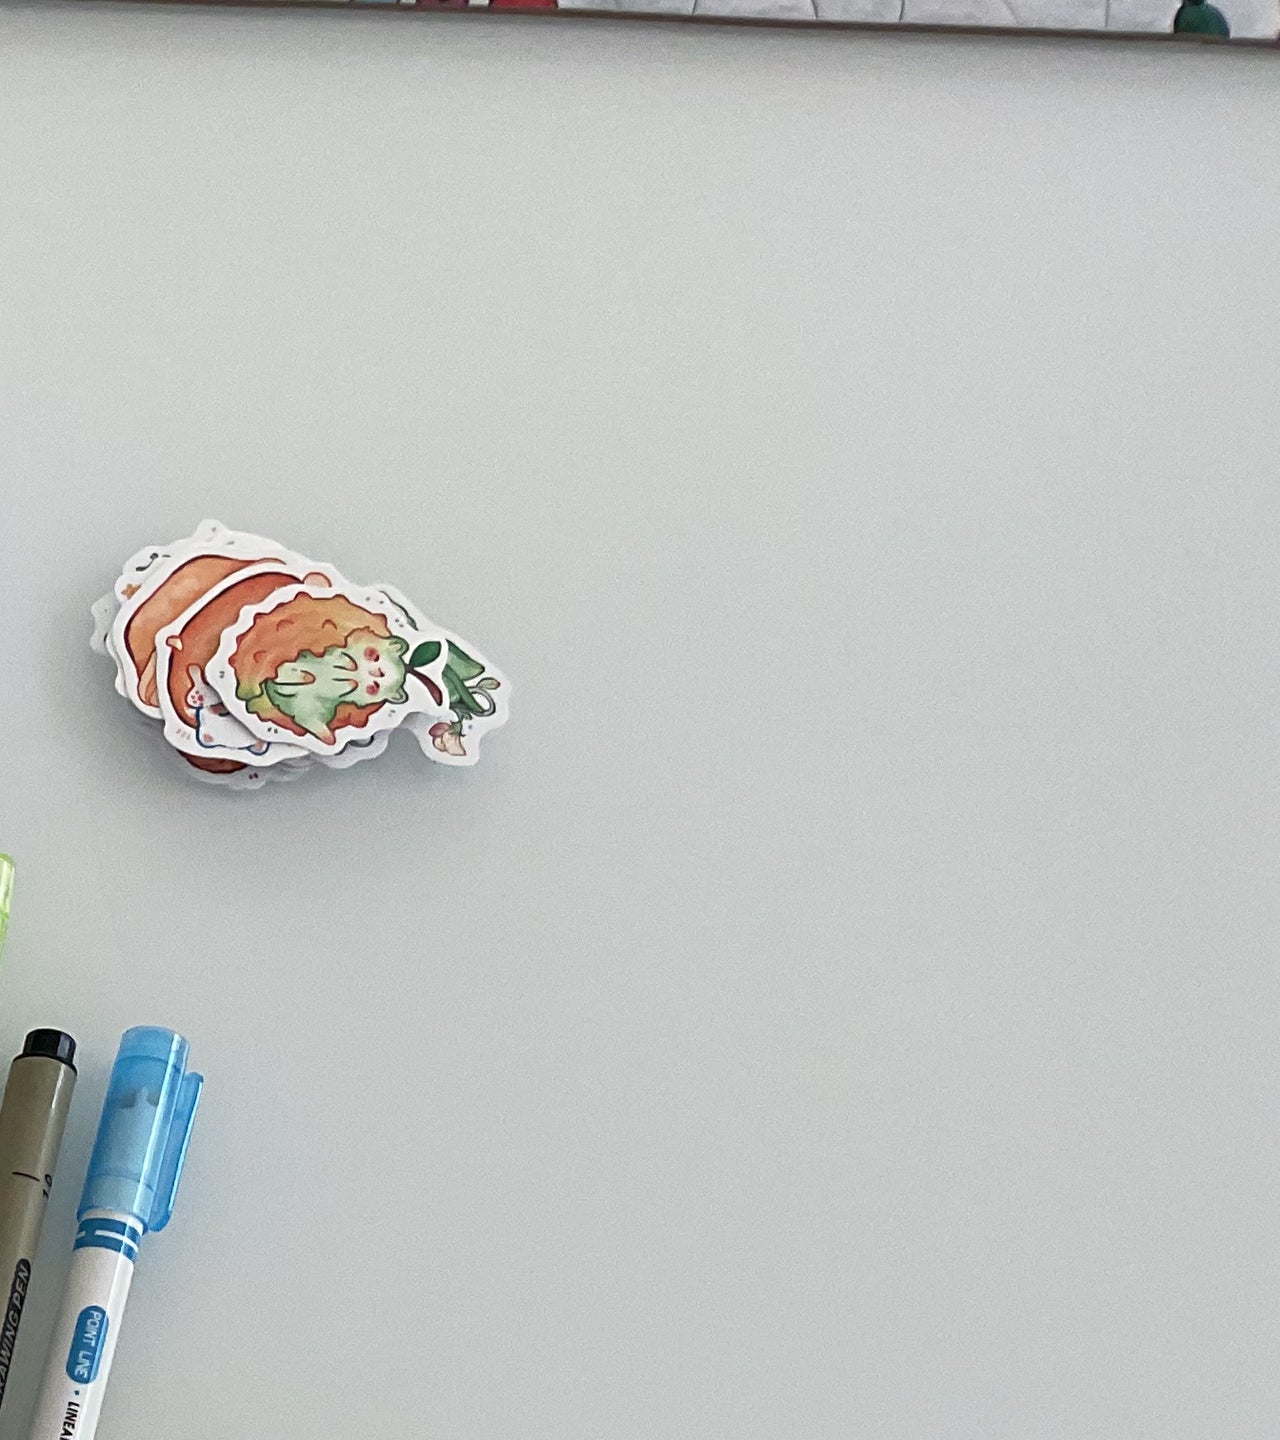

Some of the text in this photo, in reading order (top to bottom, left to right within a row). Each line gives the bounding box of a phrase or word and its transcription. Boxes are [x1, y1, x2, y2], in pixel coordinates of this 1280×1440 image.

[9, 1264, 31, 1310] PEN
[74, 1310, 103, 1379] POINT LINE
